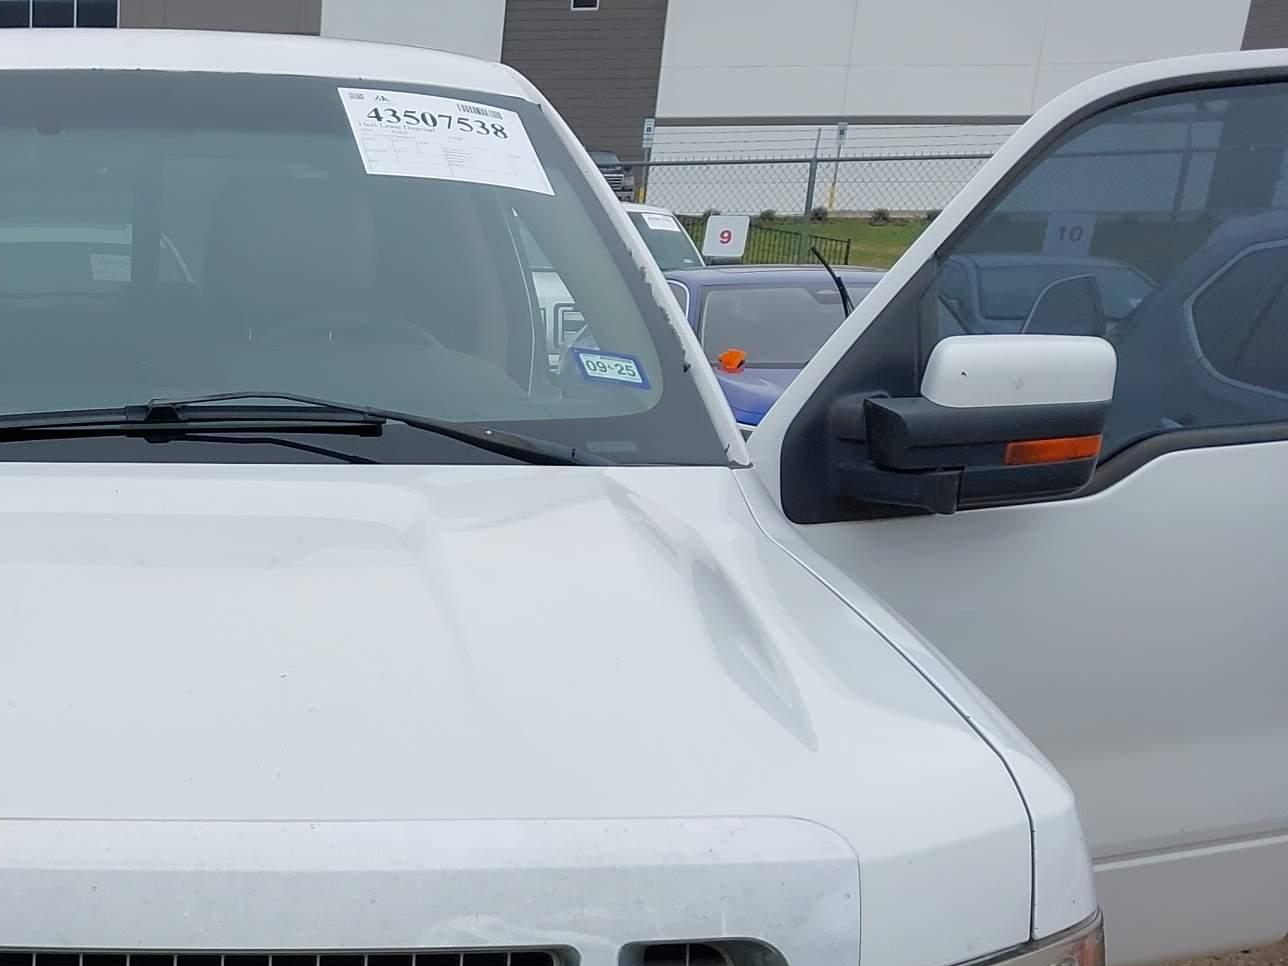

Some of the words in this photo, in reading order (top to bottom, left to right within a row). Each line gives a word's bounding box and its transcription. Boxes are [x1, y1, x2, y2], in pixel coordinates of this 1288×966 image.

[366, 107, 509, 140] 43507538
[719, 229, 733, 245] 9
[1058, 225, 1084, 242] 10
